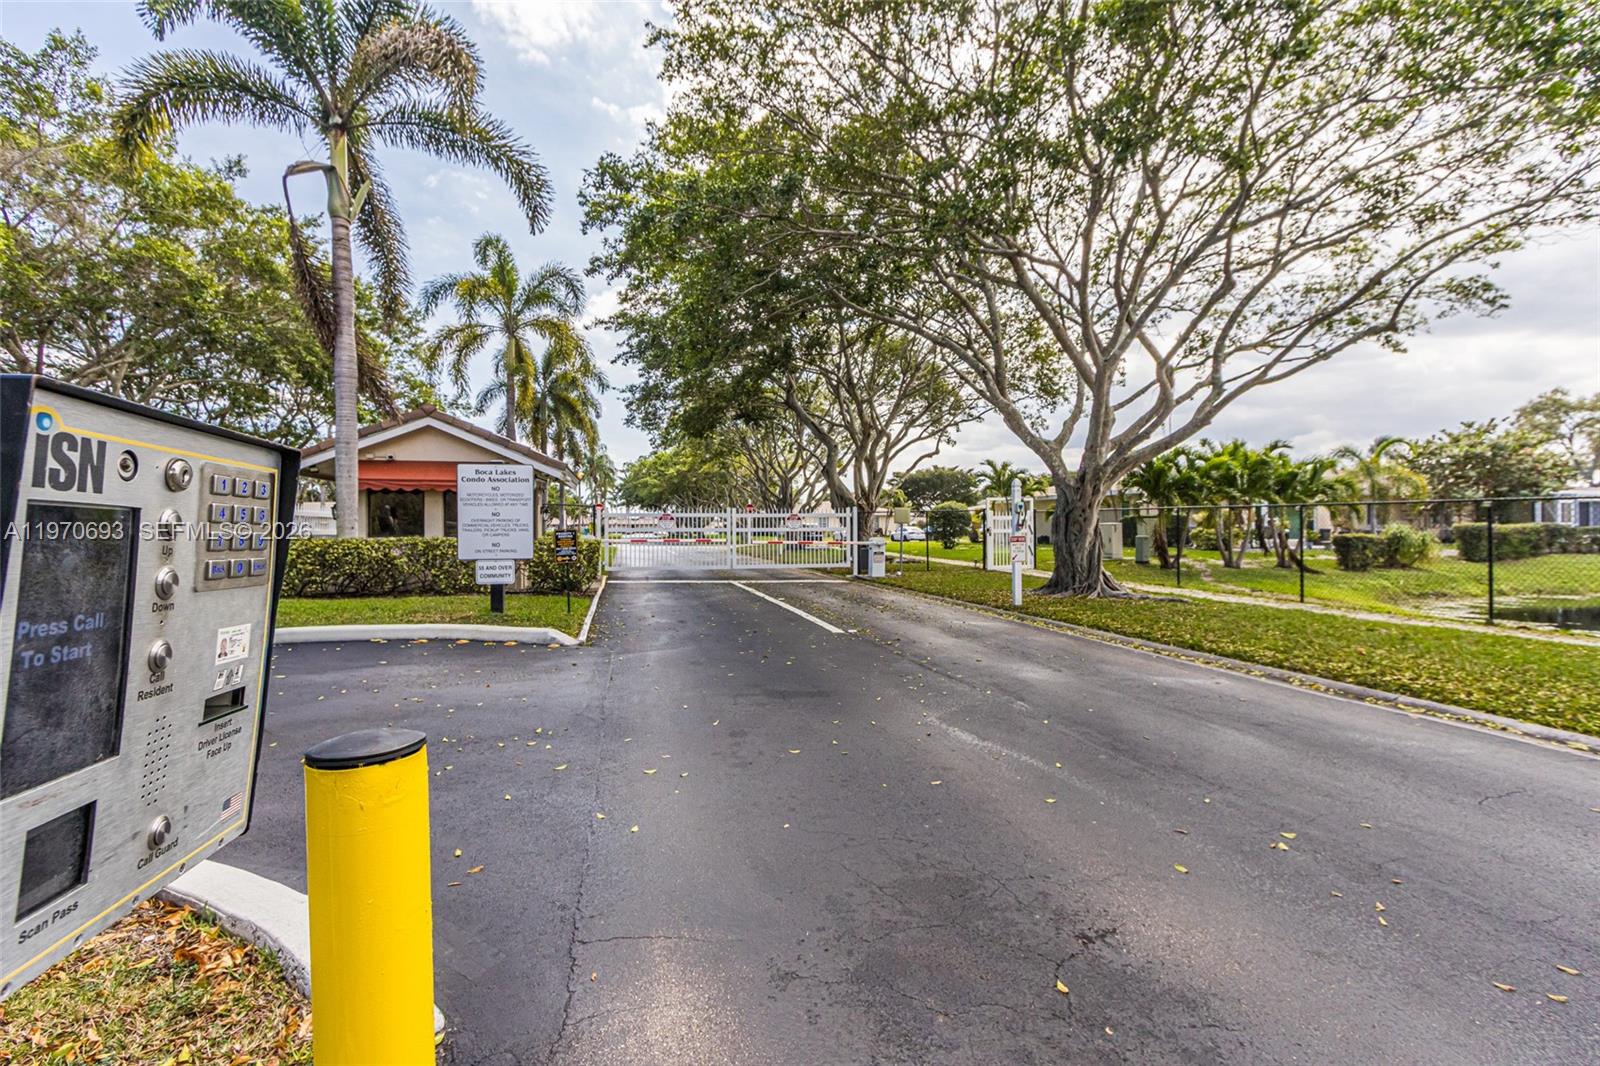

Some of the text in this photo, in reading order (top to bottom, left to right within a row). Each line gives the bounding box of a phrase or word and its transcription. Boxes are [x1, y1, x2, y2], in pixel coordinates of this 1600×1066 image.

[222, 479, 267, 495] 1 2 3
[219, 507, 225, 519] 4
[240, 508, 246, 520] 5
[162, 545, 173, 557] Up
[152, 602, 174, 613] Down
[17, 612, 105, 640] Press Call
[20, 641, 93, 669] To Start
[149, 671, 165, 684] Call
[137, 683, 174, 702] Resident
[214, 719, 233, 733] Insert
[198, 726, 243, 752] Driver License
[206, 741, 232, 760] Face Up
[137, 837, 179, 870] Call Guard
[18, 900, 79, 945] Scan Pass
